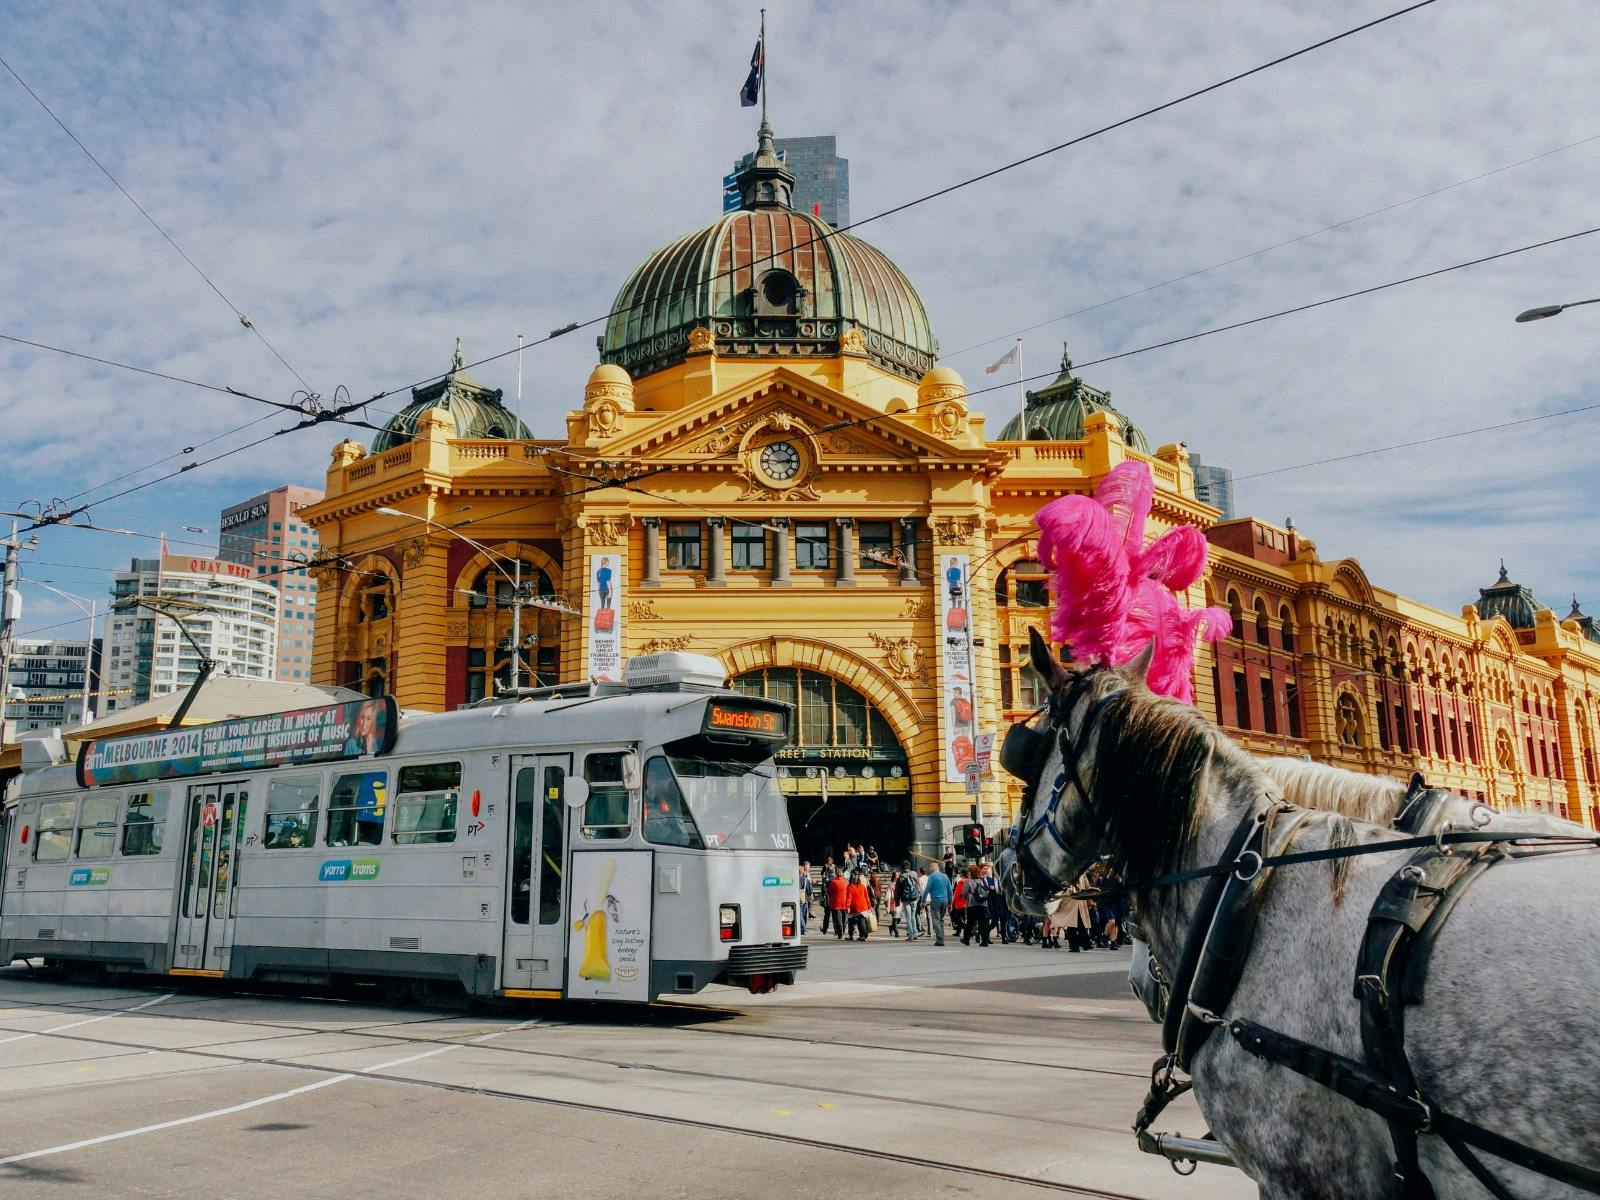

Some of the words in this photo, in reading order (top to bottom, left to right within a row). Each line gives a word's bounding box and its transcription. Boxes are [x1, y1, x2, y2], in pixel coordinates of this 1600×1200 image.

[251, 503, 268, 518] SUN
[190, 559, 221, 574] QUAY
[228, 564, 250, 579] WEST
[204, 725, 227, 741] START
[228, 722, 250, 738] YOUR
[251, 718, 282, 735] CAREER
[283, 716, 295, 730] IN
[296, 713, 323, 729] MUSIC
[324, 710, 337, 725] AT
[712, 707, 760, 728] Swanston
[763, 713, 775, 731] St
[203, 742, 217, 756] THE
[218, 735, 266, 754] AUSTRALIAN
[267, 730, 306, 748] INSTITUTE
[308, 728, 320, 742] OF
[321, 723, 350, 741] MUSIC
[105, 738, 168, 765] MELBOURNE
[171, 733, 200, 756] 2014
[820, 748, 871, 759] STATION
[770, 833, 790, 849] 167
[323, 865, 346, 879] yarra
[352, 863, 376, 875] trams
[614, 927, 641, 935] Nature's
[624, 937, 645, 947] lasting
[617, 947, 638, 957] energy
